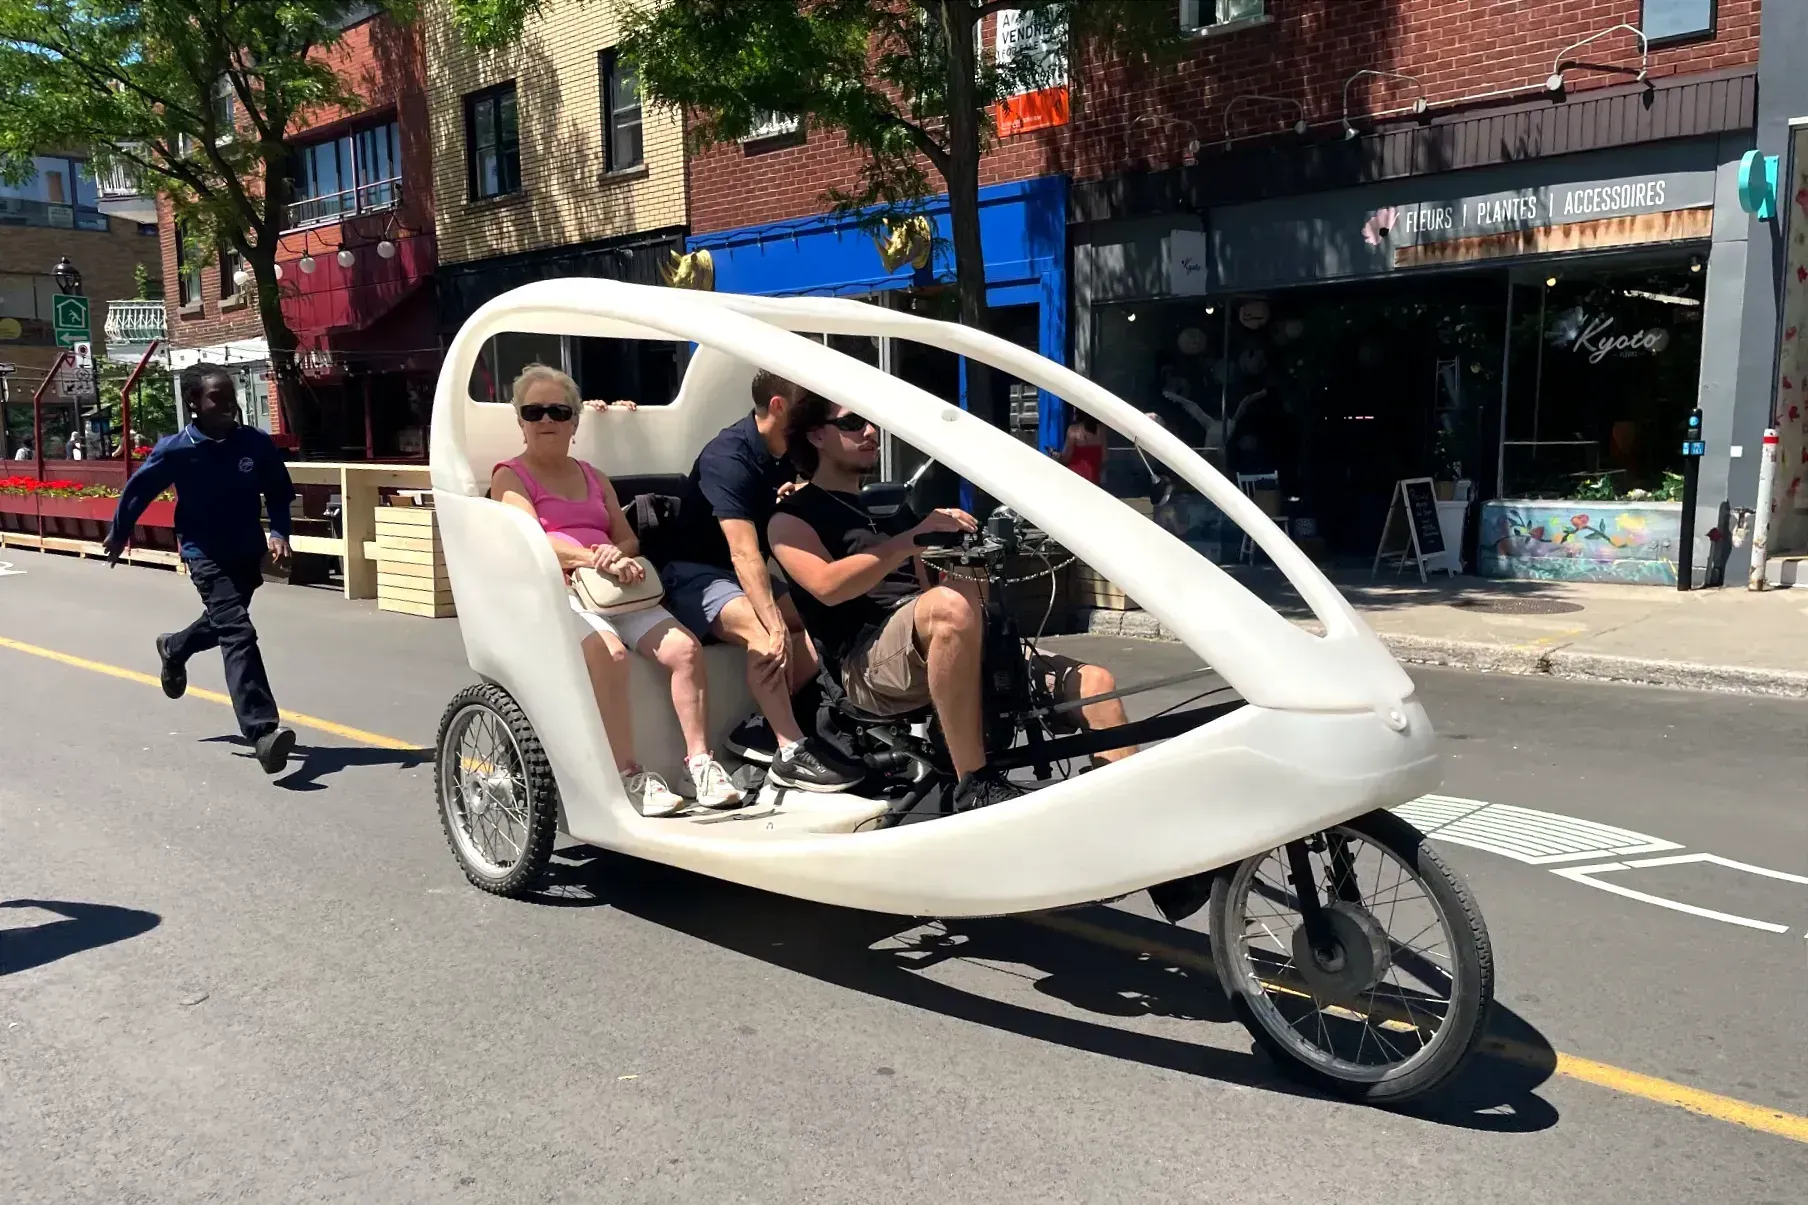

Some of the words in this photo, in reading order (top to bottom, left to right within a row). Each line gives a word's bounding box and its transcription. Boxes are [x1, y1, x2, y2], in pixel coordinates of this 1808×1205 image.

[1002, 22, 1050, 44] VENDRE
[1405, 207, 1452, 233] FLEURS
[1477, 196, 1537, 225] PLANTES
[1563, 180, 1666, 215] ACCESSOIRES
[1572, 316, 1662, 364] Kyoto
